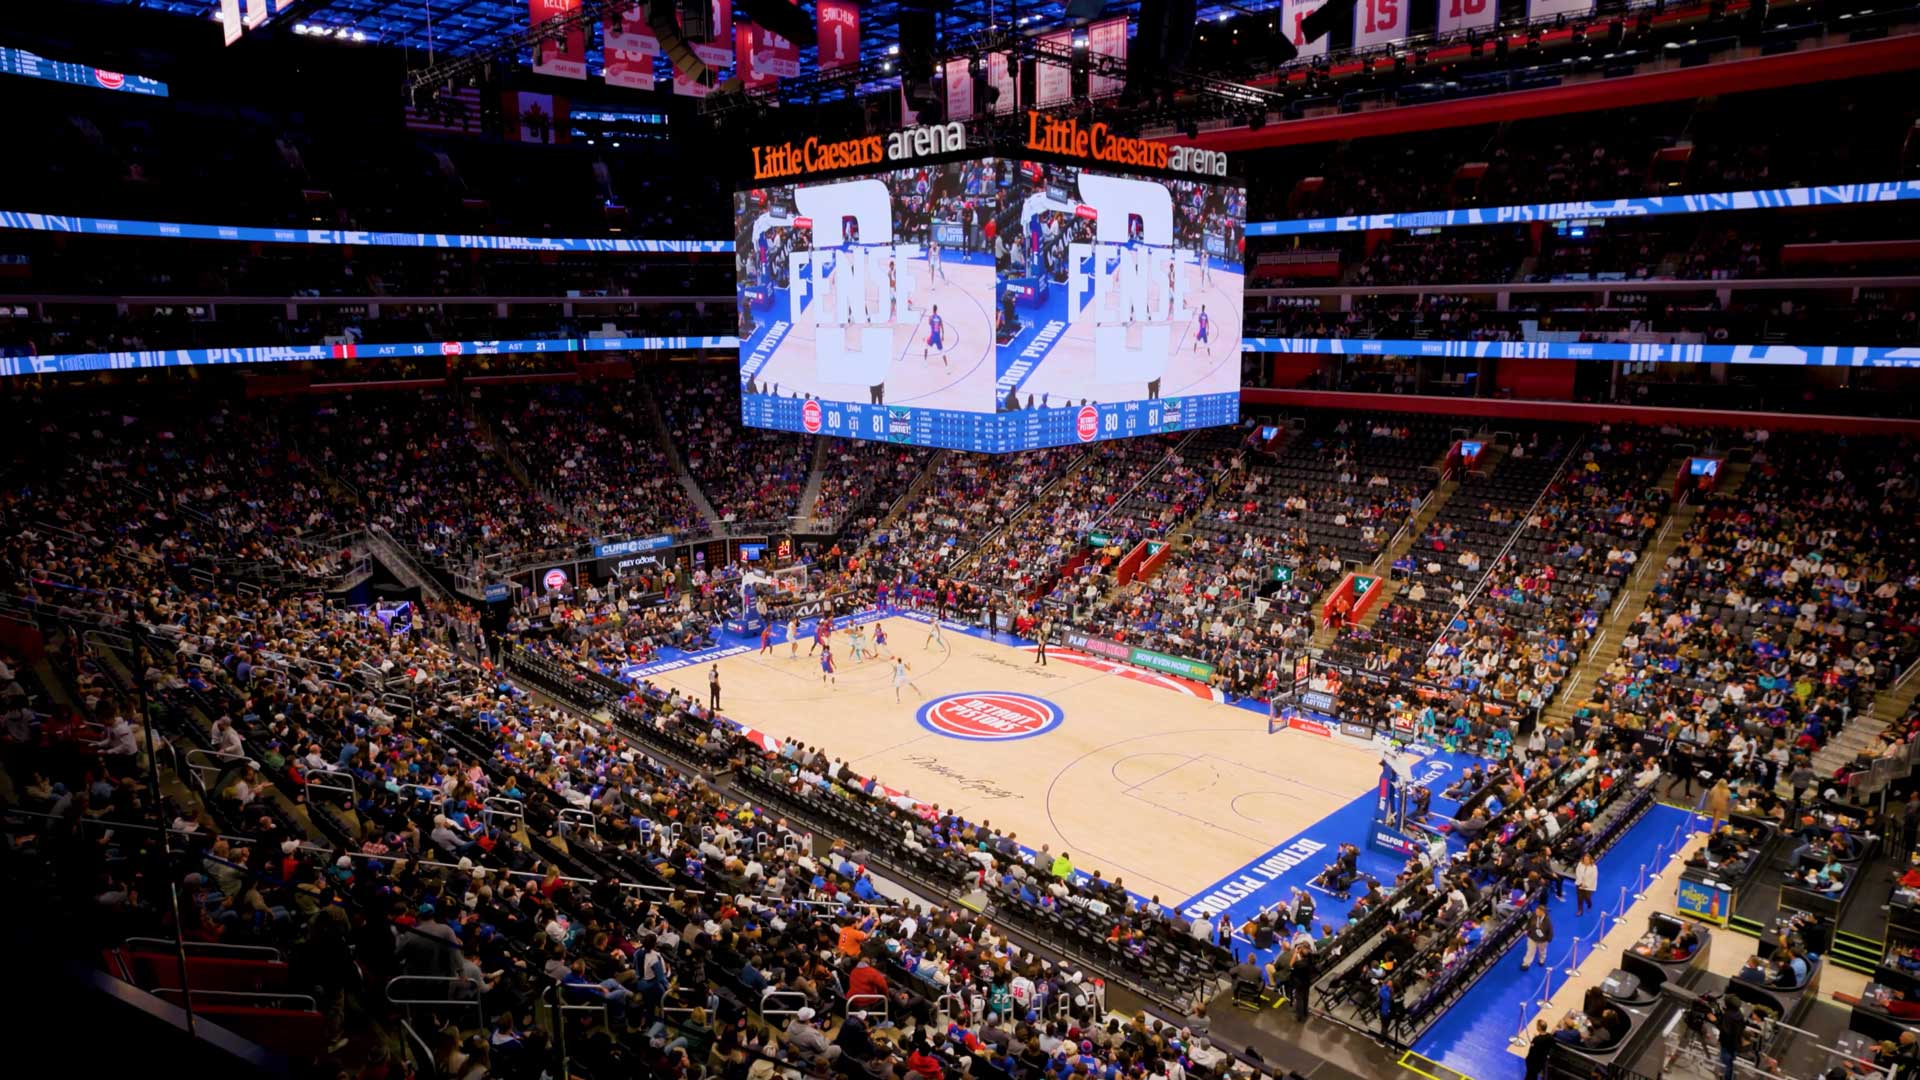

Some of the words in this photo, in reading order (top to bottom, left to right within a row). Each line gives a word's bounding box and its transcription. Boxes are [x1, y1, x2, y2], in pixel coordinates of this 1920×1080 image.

[1364, 0, 1398, 33] 15
[834, 24, 845, 60] 1
[752, 141, 802, 179] Little
[804, 135, 884, 173] Caesars
[888, 121, 967, 160] arena
[1026, 110, 1088, 157] Little
[1090, 122, 1170, 169] Caesars
[1168, 145, 1228, 177] arena
[413, 345, 424, 354] 16
[536, 342, 545, 351] 21
[740, 352, 766, 384] ETROIT
[996, 359, 1033, 399] ETROIT
[1020, 320, 1066, 358] PISTONS
[828, 411, 840, 428] 80
[873, 415, 883, 433] 81
[1105, 413, 1118, 432] 80
[1149, 409, 1159, 427] 81
[602, 543, 628, 554] CURE
[778, 545, 790, 556] 24
[618, 560, 635, 568] GREY
[635, 555, 657, 565] GOOSE
[1068, 635, 1087, 647] PLAY
[627, 659, 690, 679] DETROIT
[690, 645, 751, 663] PISTONS
[1135, 652, 1151, 665] NOW
[946, 705, 1020, 732] PISTONS
[964, 699, 1037, 725] DETROIT
[1377, 832, 1404, 847] BELFOR
[1252, 838, 1327, 880] DETROIT
[1184, 874, 1266, 919] PISTONS
[1013, 986, 1024, 998] 36
